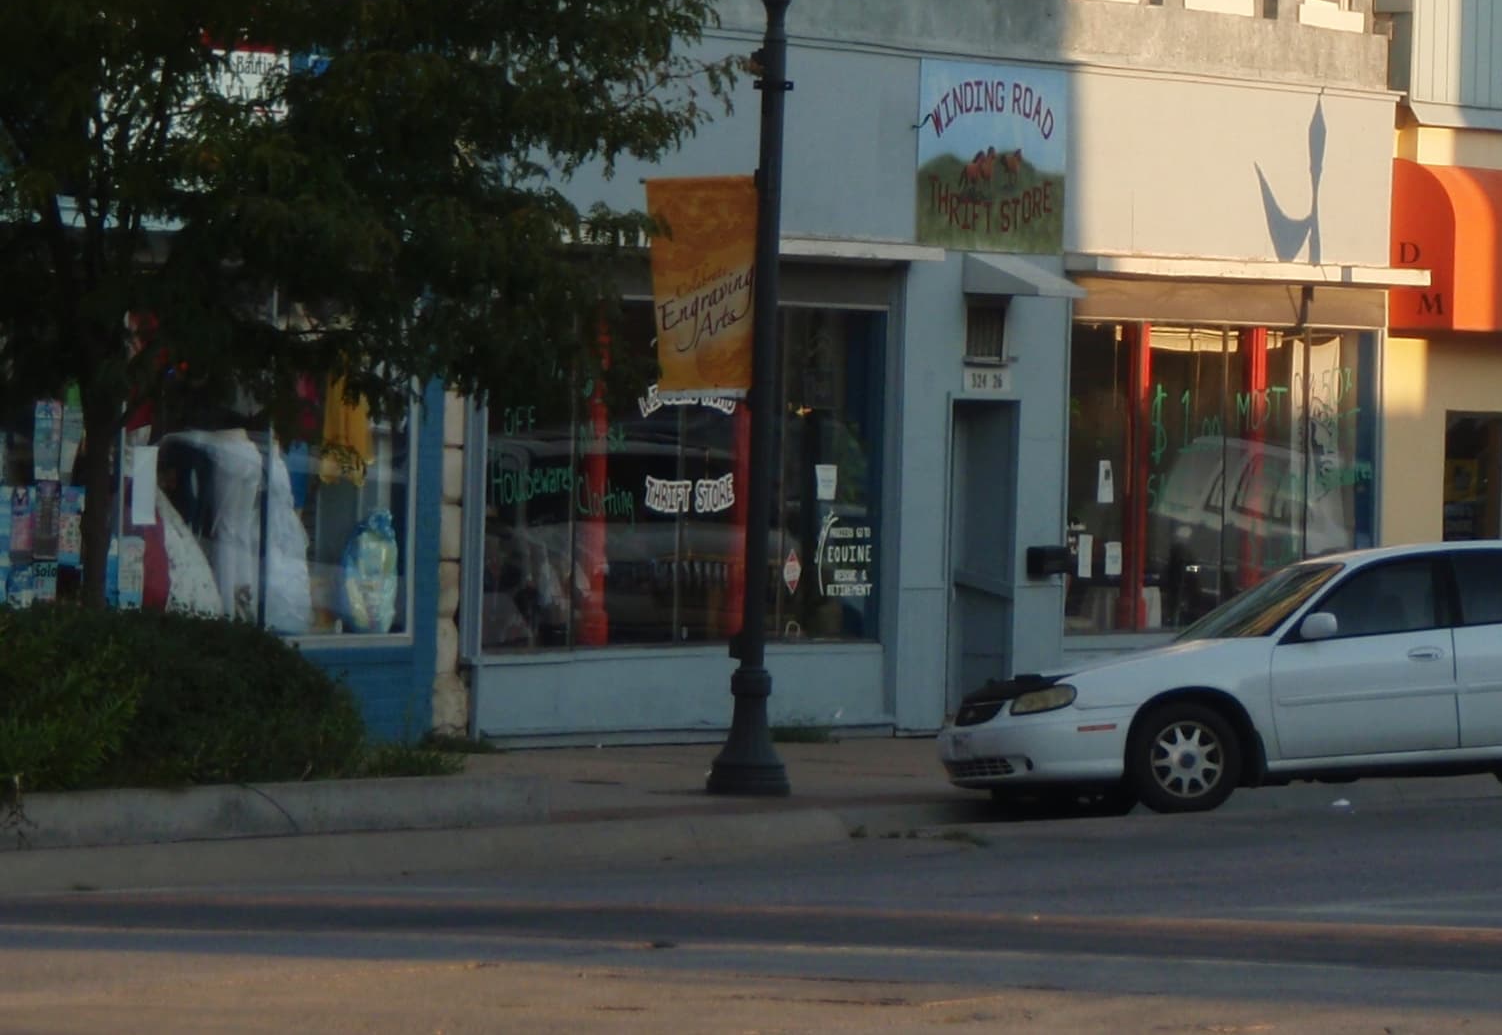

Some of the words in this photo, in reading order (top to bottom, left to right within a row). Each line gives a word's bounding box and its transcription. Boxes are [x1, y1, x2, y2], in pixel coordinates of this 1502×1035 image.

[930, 80, 1005, 138] WINDING
[1012, 82, 1054, 140] ROAD
[928, 173, 993, 233] THRIFT
[1000, 181, 1054, 233] STORE
[657, 264, 754, 353] Engraving
[694, 307, 737, 349] Arts
[645, 475, 692, 513] THRIFT
[695, 473, 735, 513] STORE
[827, 545, 872, 563] EQUINE
